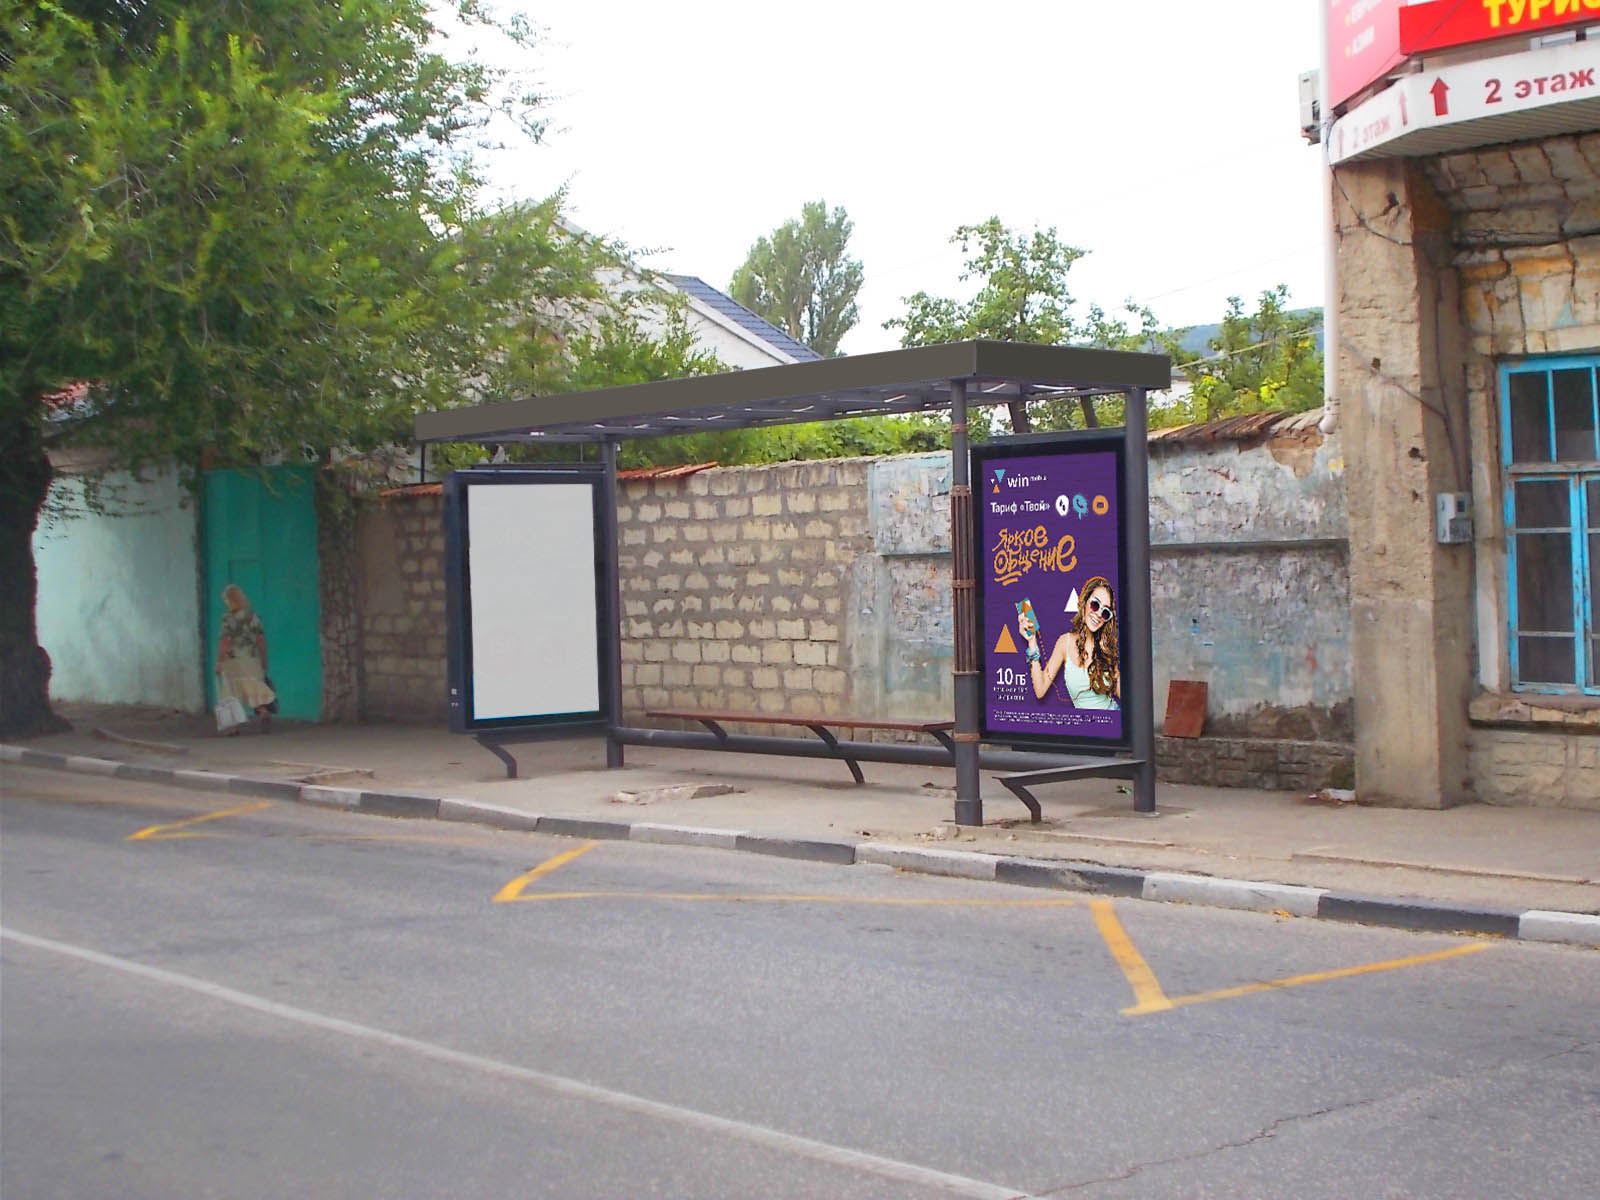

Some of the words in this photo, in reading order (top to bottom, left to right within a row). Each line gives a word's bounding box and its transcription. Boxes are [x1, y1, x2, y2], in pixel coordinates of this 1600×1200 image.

[1482, 0, 1600, 27] ТУРИ
[1484, 77, 1503, 105] 2
[1514, 67, 1595, 99] этаж
[1007, 474, 1029, 488] win
[990, 501, 1018, 516] Тариф
[1020, 499, 1050, 512] «Твой»
[996, 668, 1013, 685] 10
